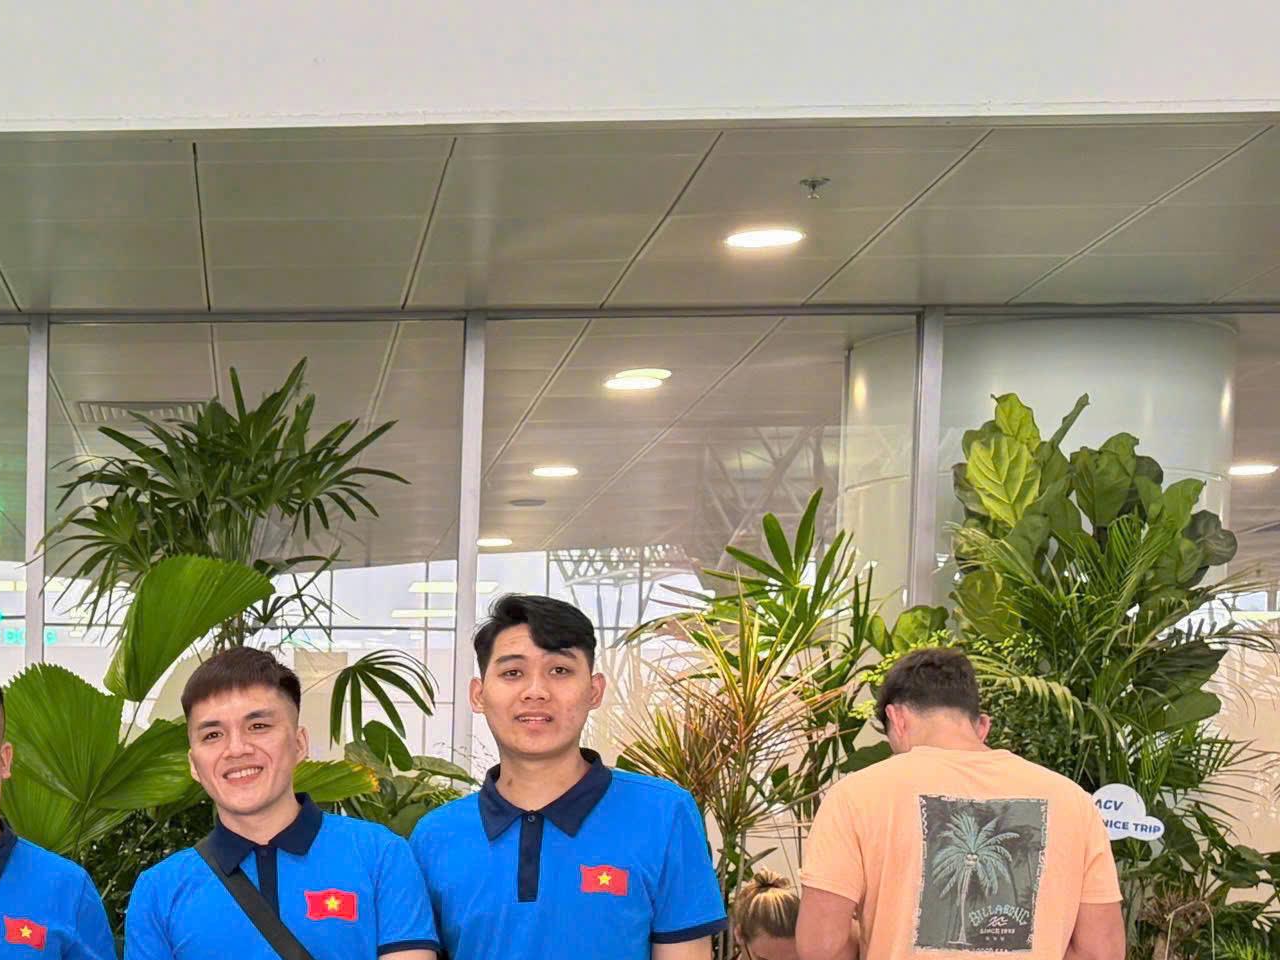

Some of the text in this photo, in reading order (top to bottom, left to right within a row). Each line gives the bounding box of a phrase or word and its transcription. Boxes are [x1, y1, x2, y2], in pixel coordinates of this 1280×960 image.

[1095, 798, 1123, 811] ACV
[1133, 822, 1161, 833] TRIP
[968, 904, 1030, 927] BILLABONG
